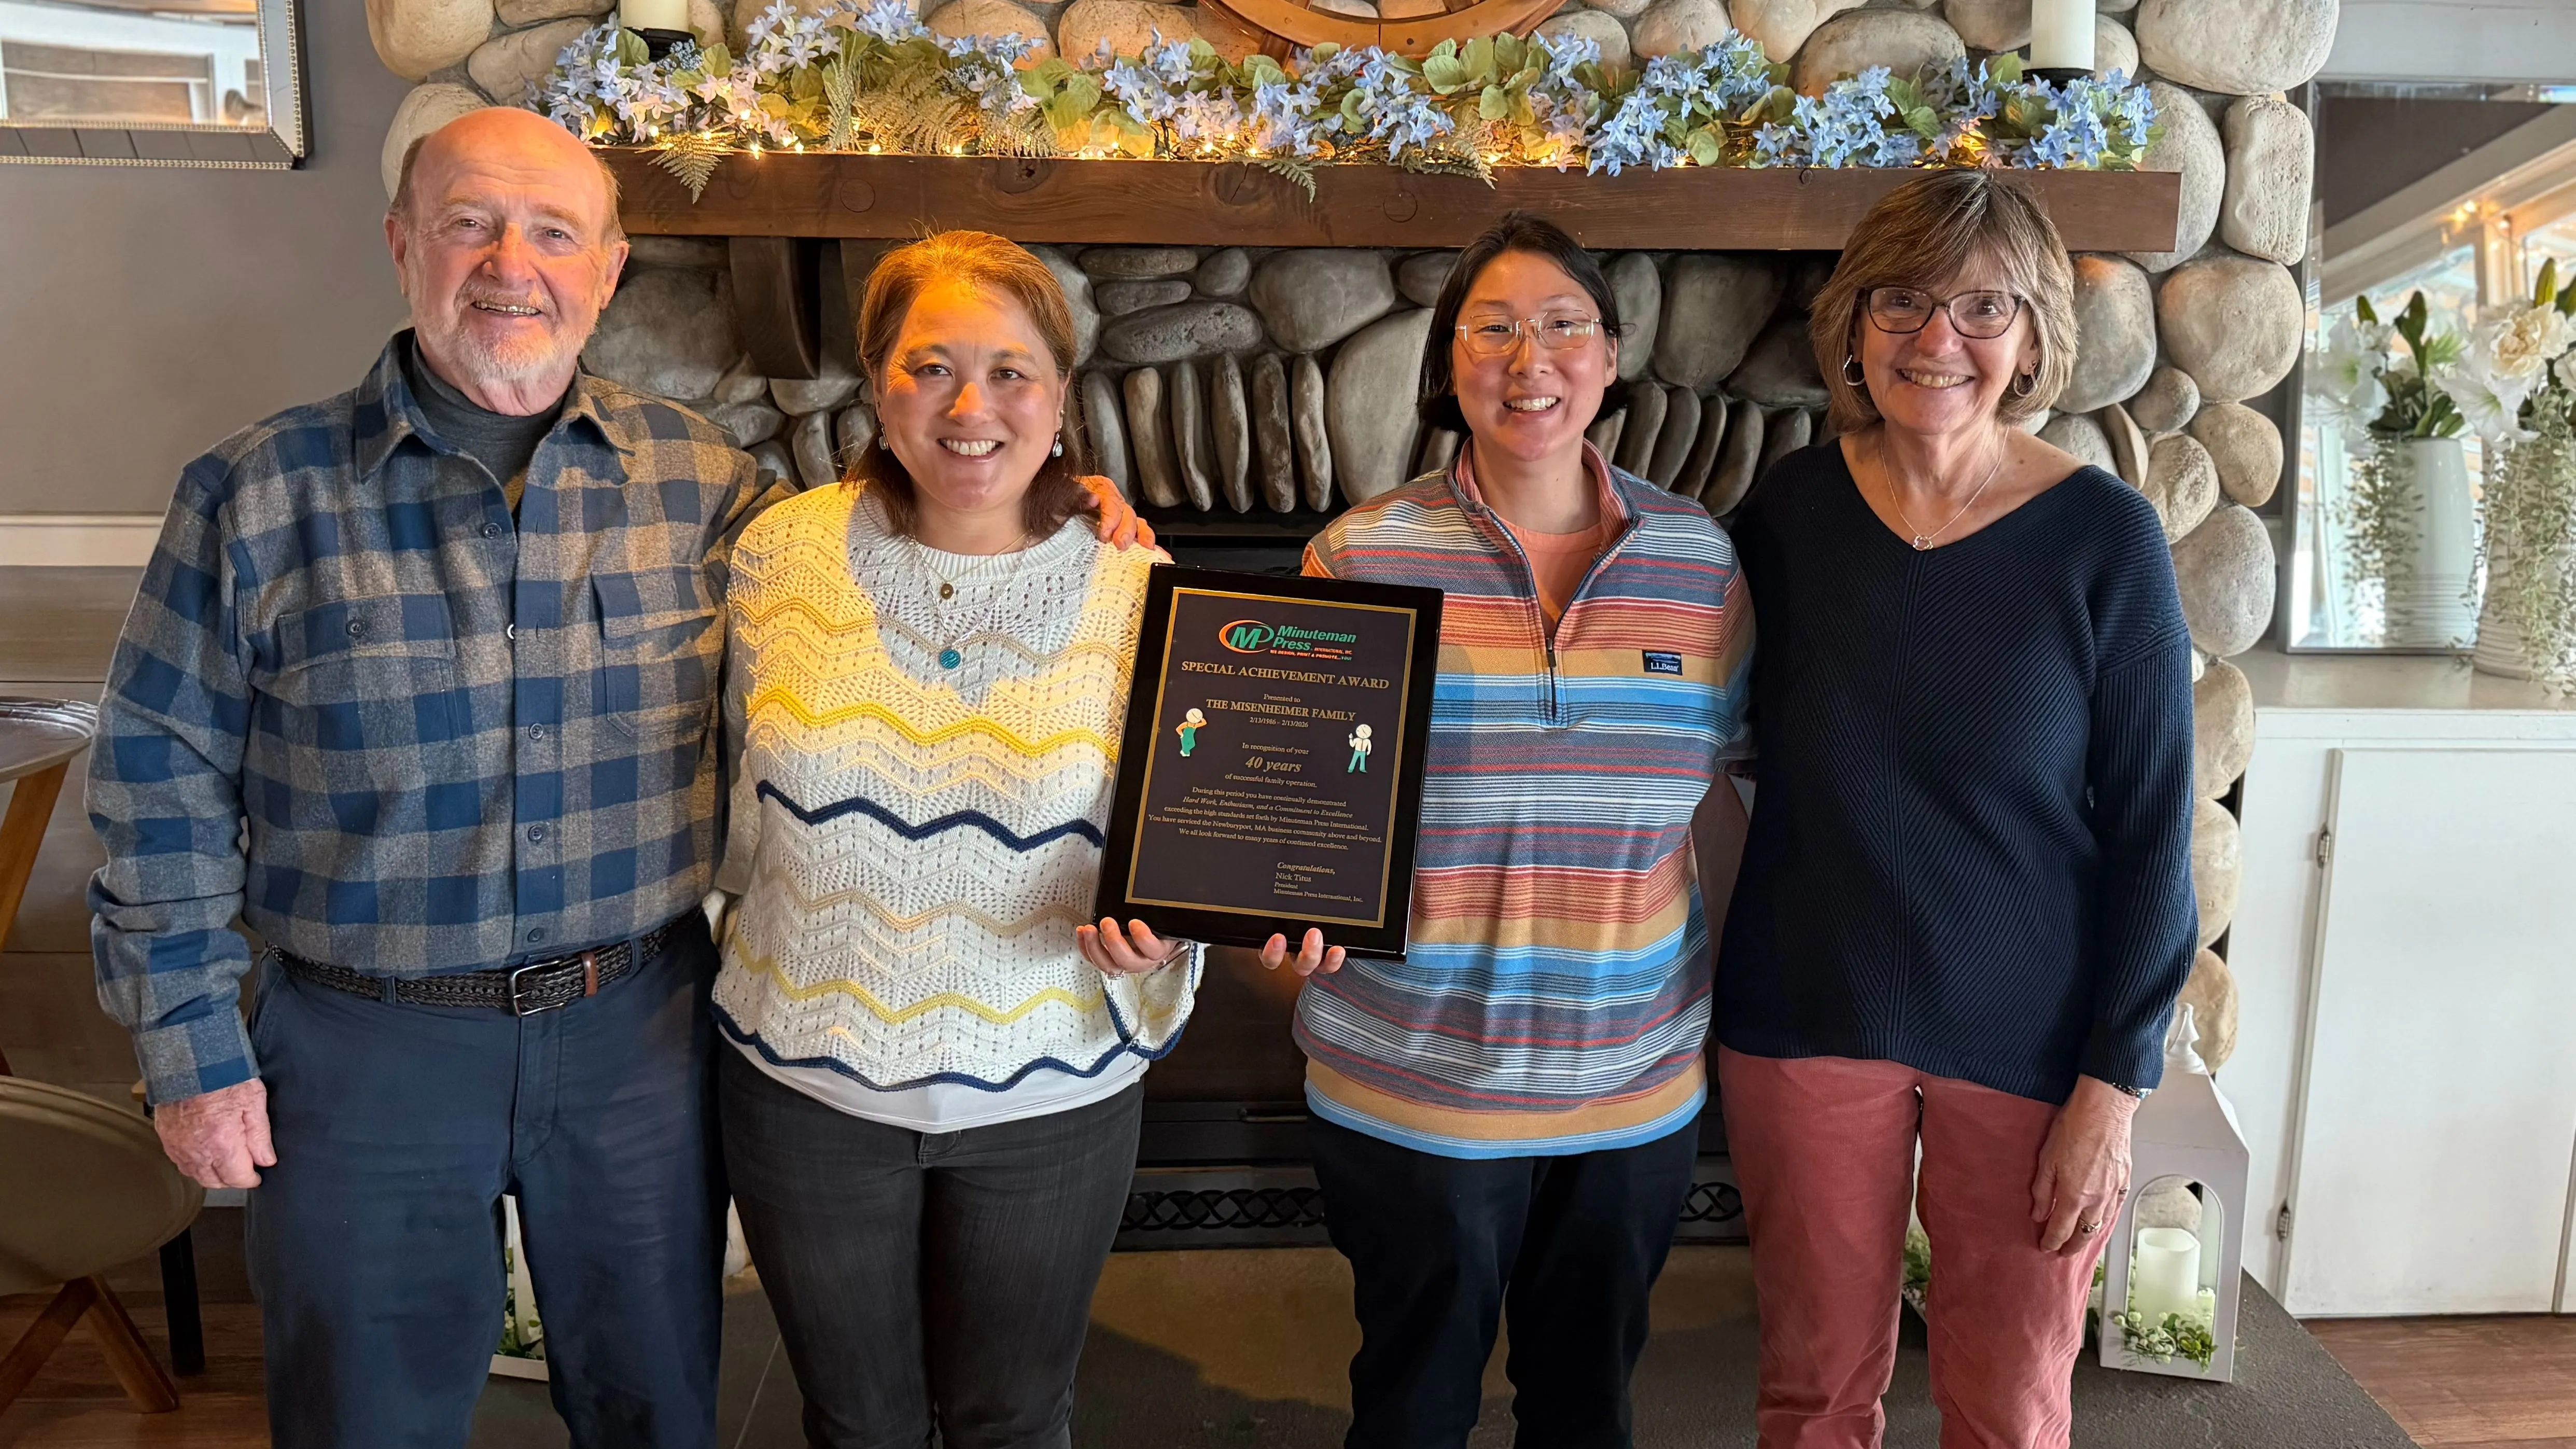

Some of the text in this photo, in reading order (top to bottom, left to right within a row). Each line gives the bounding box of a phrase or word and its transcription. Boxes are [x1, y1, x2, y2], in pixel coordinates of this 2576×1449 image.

[1278, 625, 1356, 643] Minuteman
[1273, 637, 1311, 651] Press
[1182, 661, 1389, 689] SPECIAL ACHIEVEMENT AWARD
[1263, 694, 1293, 702] Presented
[1206, 699, 1356, 721] THE MISENHEIMER FAMILY
[1245, 756, 1301, 772] 40 years
[1265, 777, 1285, 785] family
[1286, 779, 1317, 788] operation.
[1193, 787, 1213, 795] During
[1273, 796, 1306, 804] continually
[1307, 798, 1346, 806] demonstrated
[1220, 800, 1254, 809] Enthusiasm,
[1275, 805, 1312, 814] Commitment
[1321, 810, 1353, 818] Excellence
[1164, 806, 1193, 815] exceeding
[1279, 816, 1312, 825] Minuteman
[1331, 821, 1368, 830] International.
[1212, 820, 1253, 831] Newburyport,
[1359, 834, 1381, 843] beyond.
[1213, 831, 1236, 840] forward
[1276, 872, 1293, 881] Nick
[1277, 862, 1335, 875] Congratulations,
[1319, 893, 1352, 902] International,
